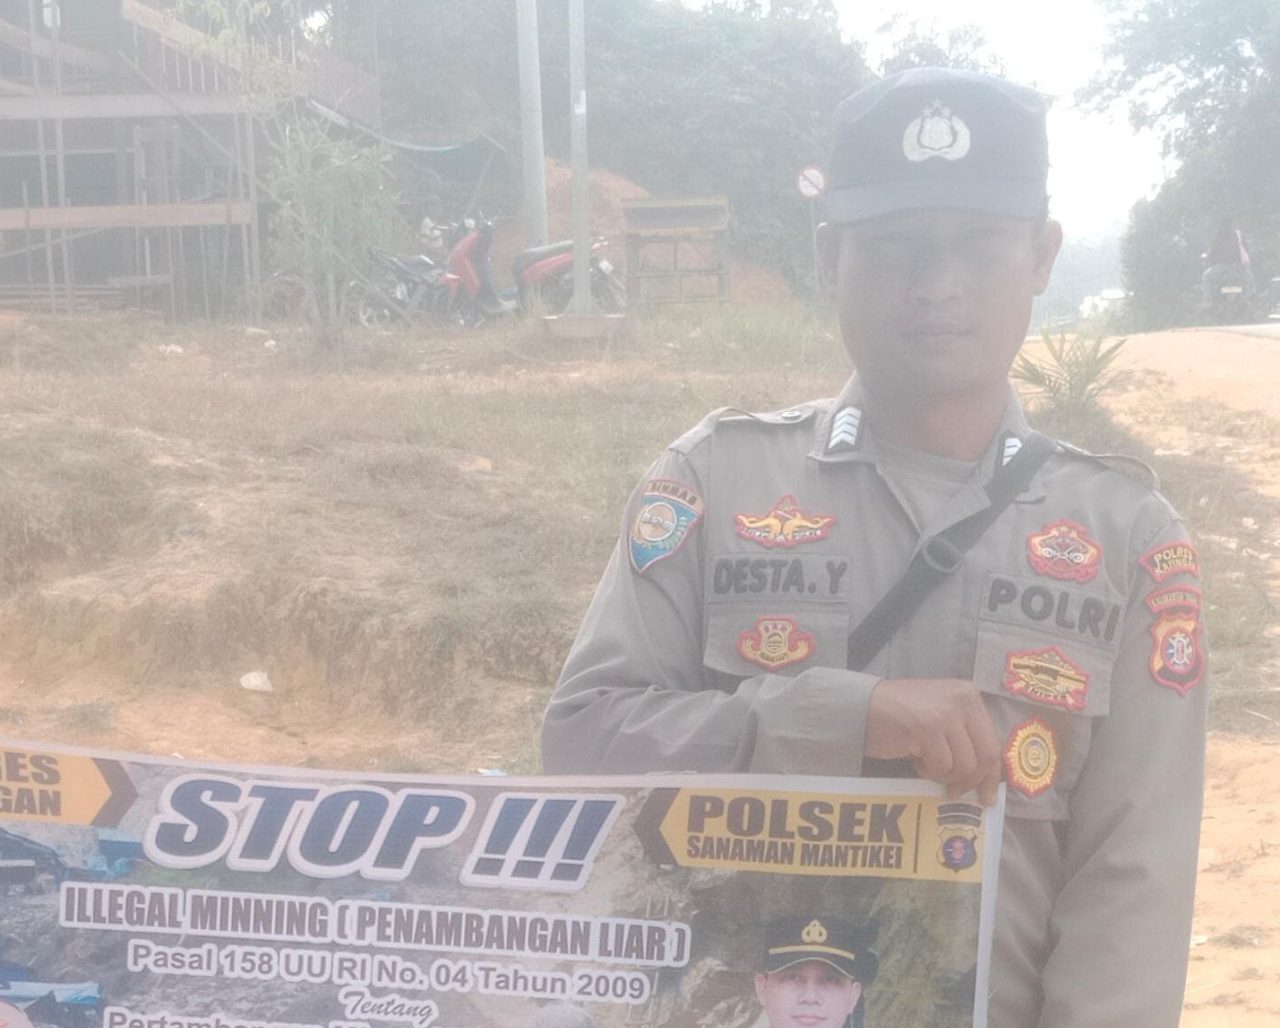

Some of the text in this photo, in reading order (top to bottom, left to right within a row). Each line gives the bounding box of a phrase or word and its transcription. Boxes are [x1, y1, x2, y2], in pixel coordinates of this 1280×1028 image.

[988, 578, 1121, 641] POLRI
[155, 777, 469, 869] STOP
[687, 795, 908, 843] POLSEK
[686, 835, 903, 869] SANAMAN MANTIKEI
[64, 887, 183, 928] ILLEGAL
[190, 893, 329, 938] MINNING
[132, 944, 645, 999] Pasal 158 UU RI No. 04 Tahun 2009
[342, 991, 435, 1026] Tentang
